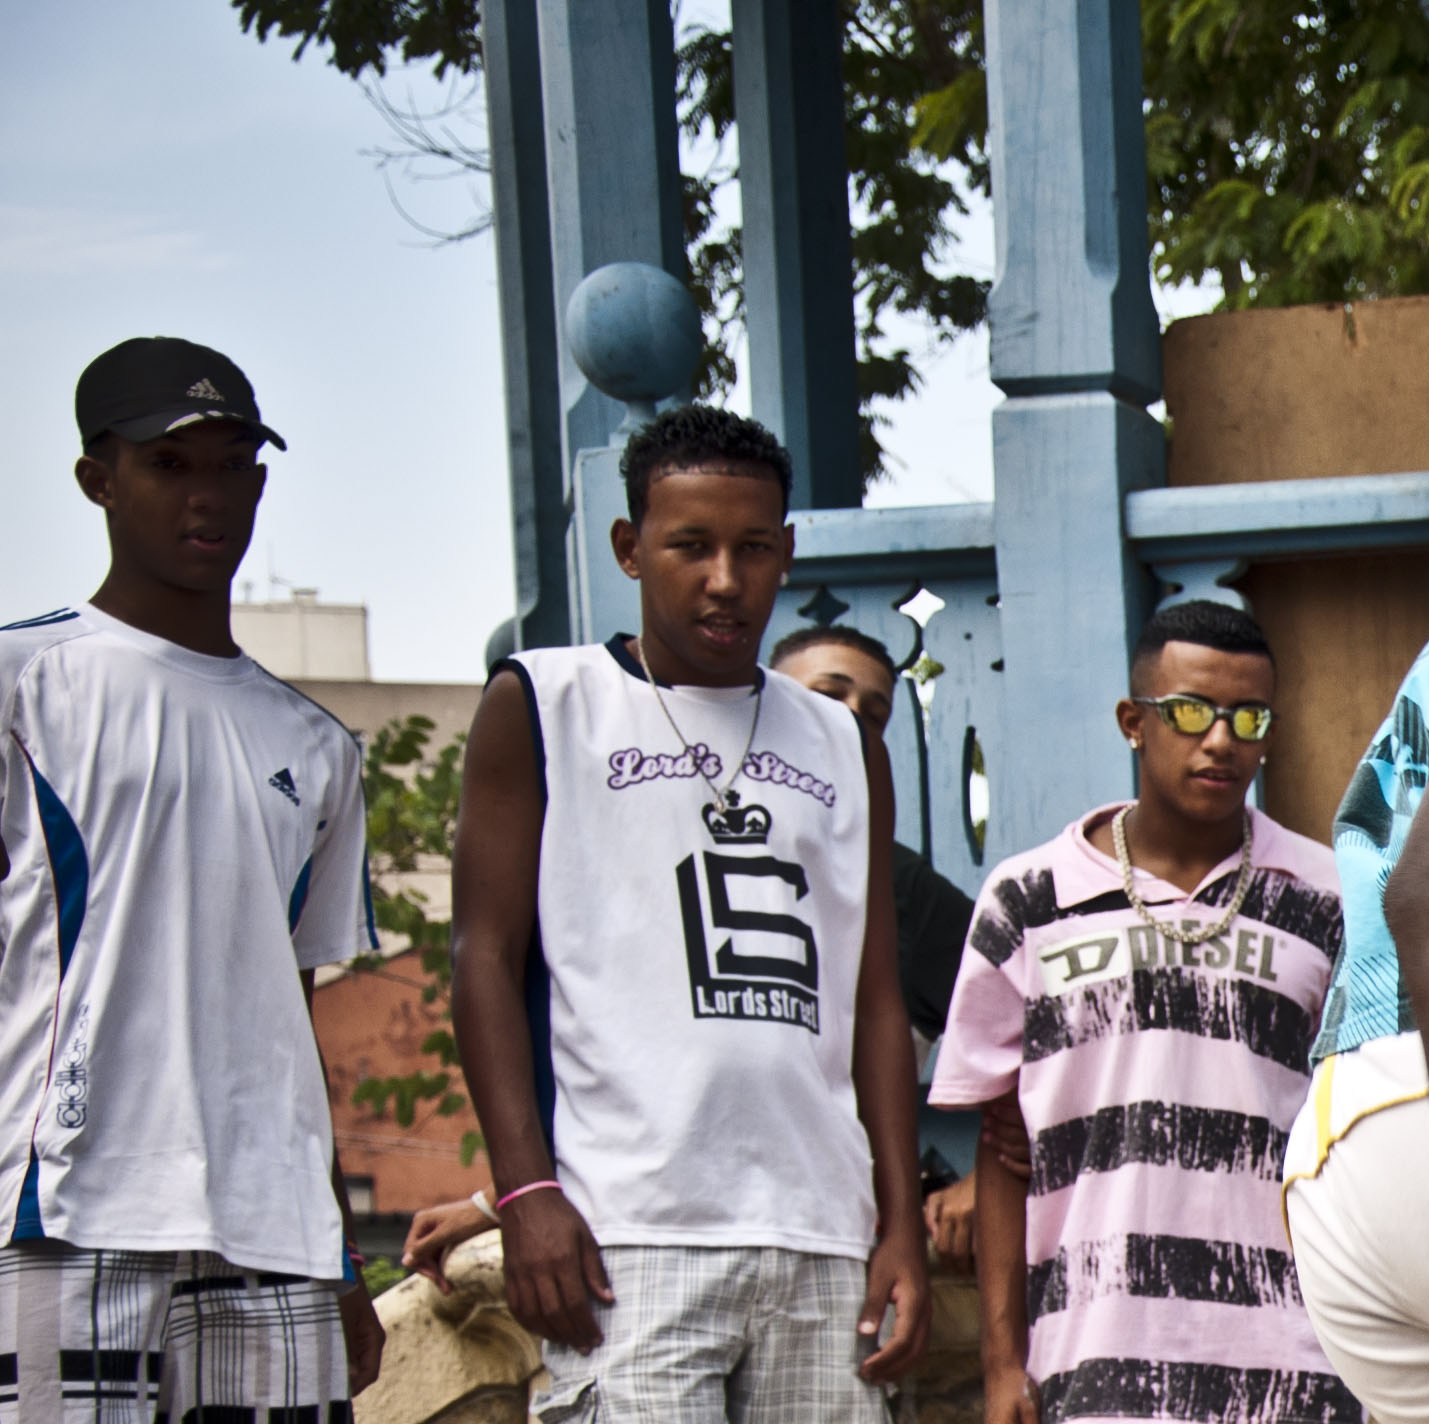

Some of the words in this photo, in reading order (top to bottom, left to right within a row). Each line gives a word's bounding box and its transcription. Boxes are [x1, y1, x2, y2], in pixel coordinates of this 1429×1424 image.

[608, 743, 723, 790] Lord's
[743, 751, 836, 807] Street
[1127, 919, 1278, 982] DIESEL
[696, 985, 767, 1016] Lords
